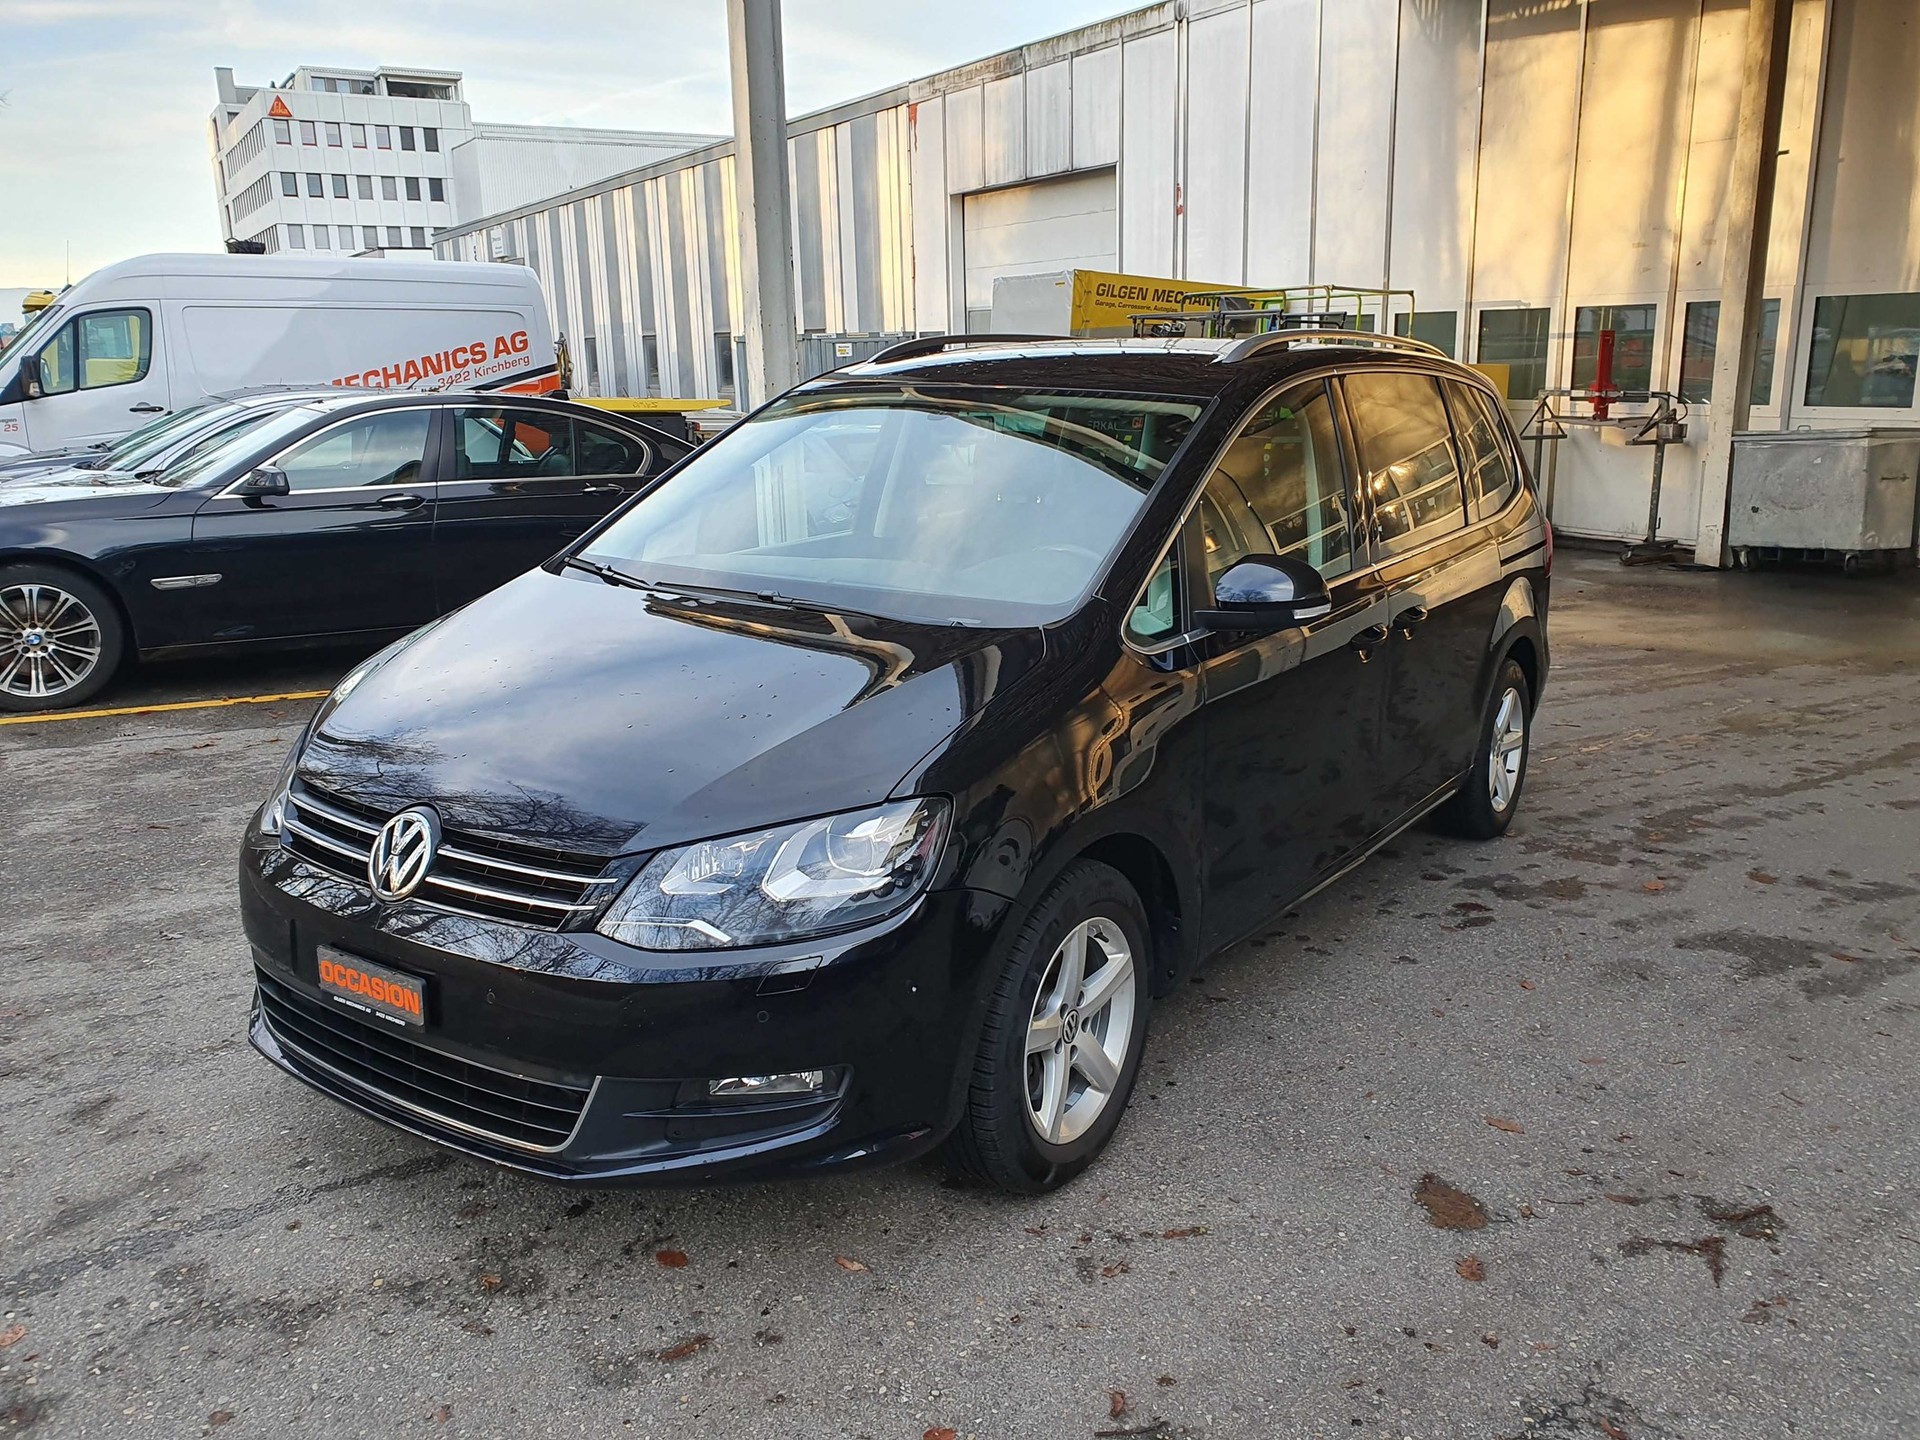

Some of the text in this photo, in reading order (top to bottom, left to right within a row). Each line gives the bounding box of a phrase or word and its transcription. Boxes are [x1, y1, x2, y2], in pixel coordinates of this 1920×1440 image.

[1096, 282, 1149, 301] GILGEN
[1095, 299, 1117, 308] Garage,
[493, 331, 529, 359] AG
[438, 356, 530, 389] 3422 Kirchberg
[4, 424, 18, 432] 25
[321, 960, 420, 1015] OCCASION
